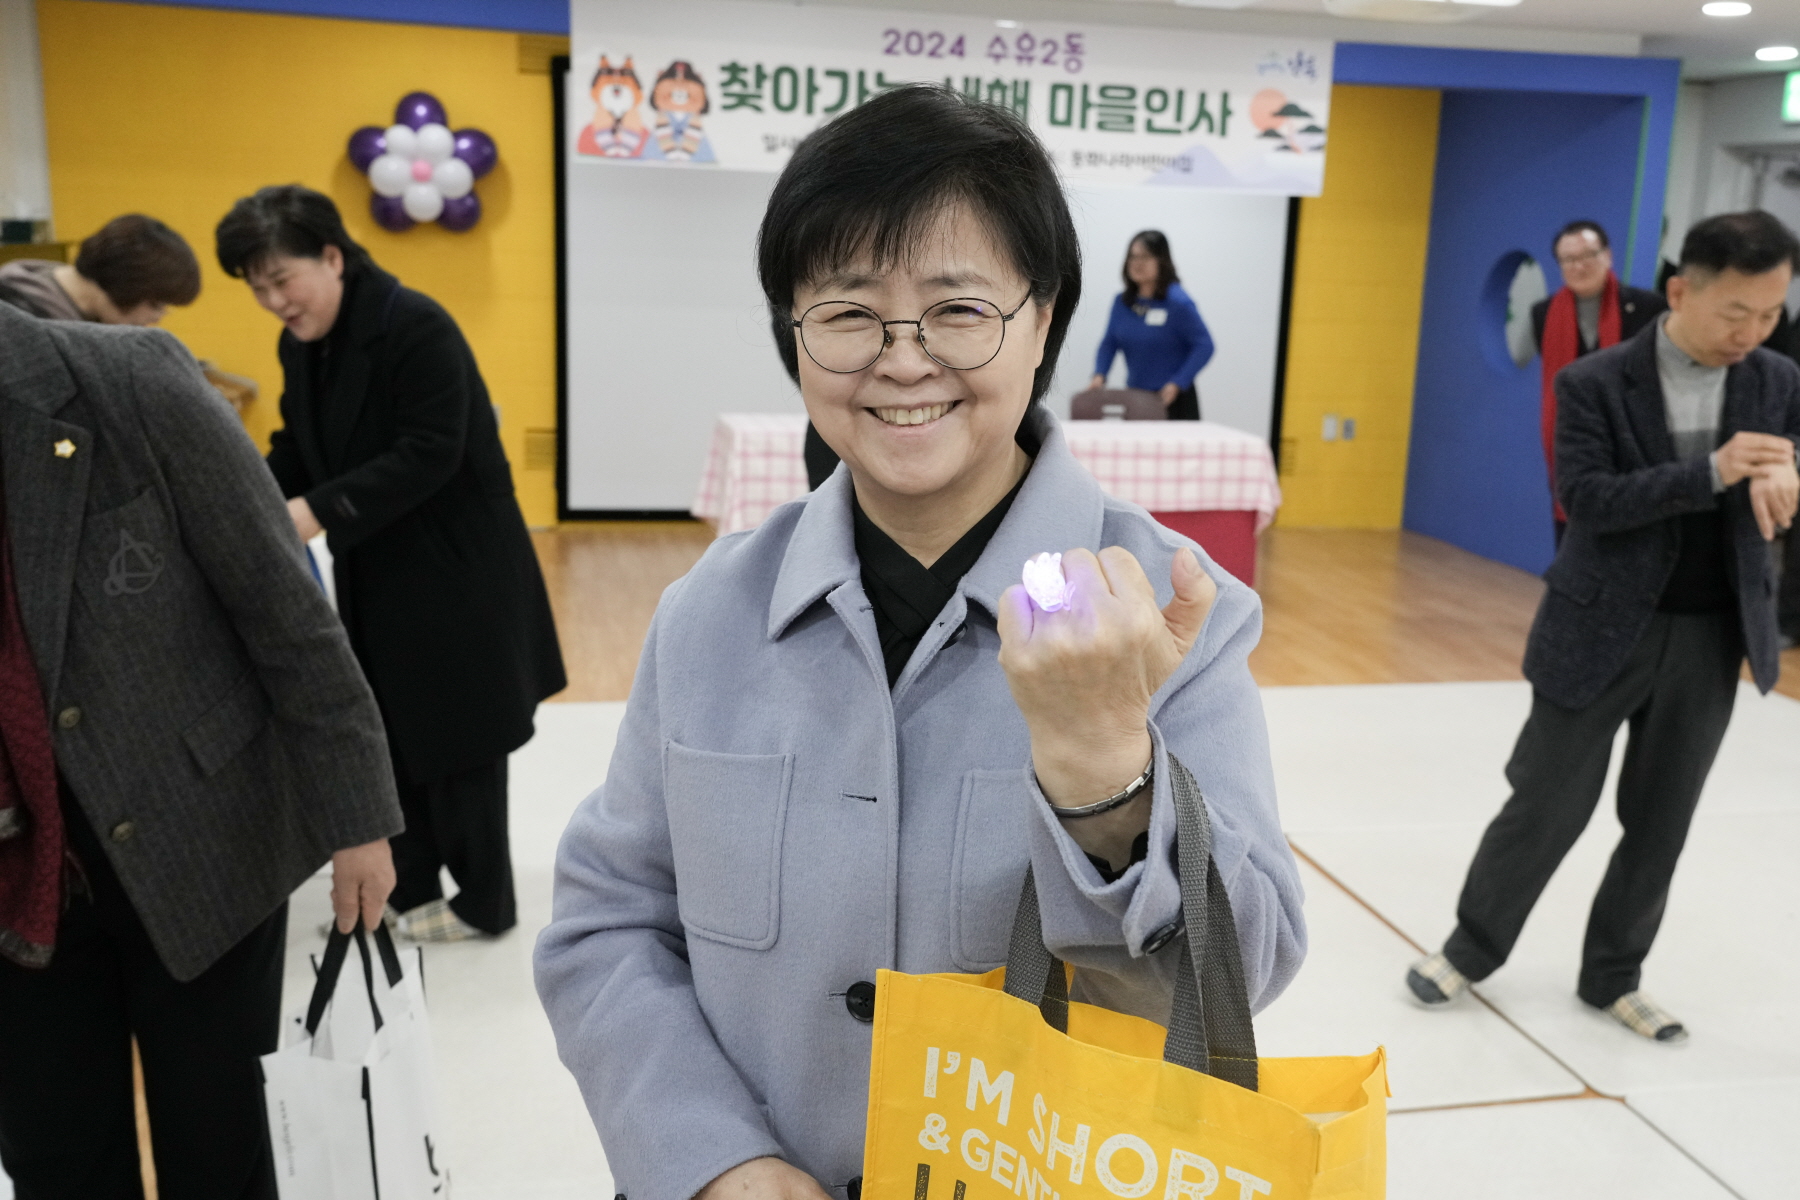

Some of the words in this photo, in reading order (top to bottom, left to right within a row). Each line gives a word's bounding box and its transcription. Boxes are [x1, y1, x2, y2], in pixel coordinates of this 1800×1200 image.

[883, 28, 966, 59] 2024
[986, 31, 1084, 74] 수유2동
[1048, 81, 1233, 138] 마을인사
[917, 1112, 951, 1154] &
[960, 1127, 1061, 1200] GENT
[1027, 1092, 1273, 1200] SHORT
